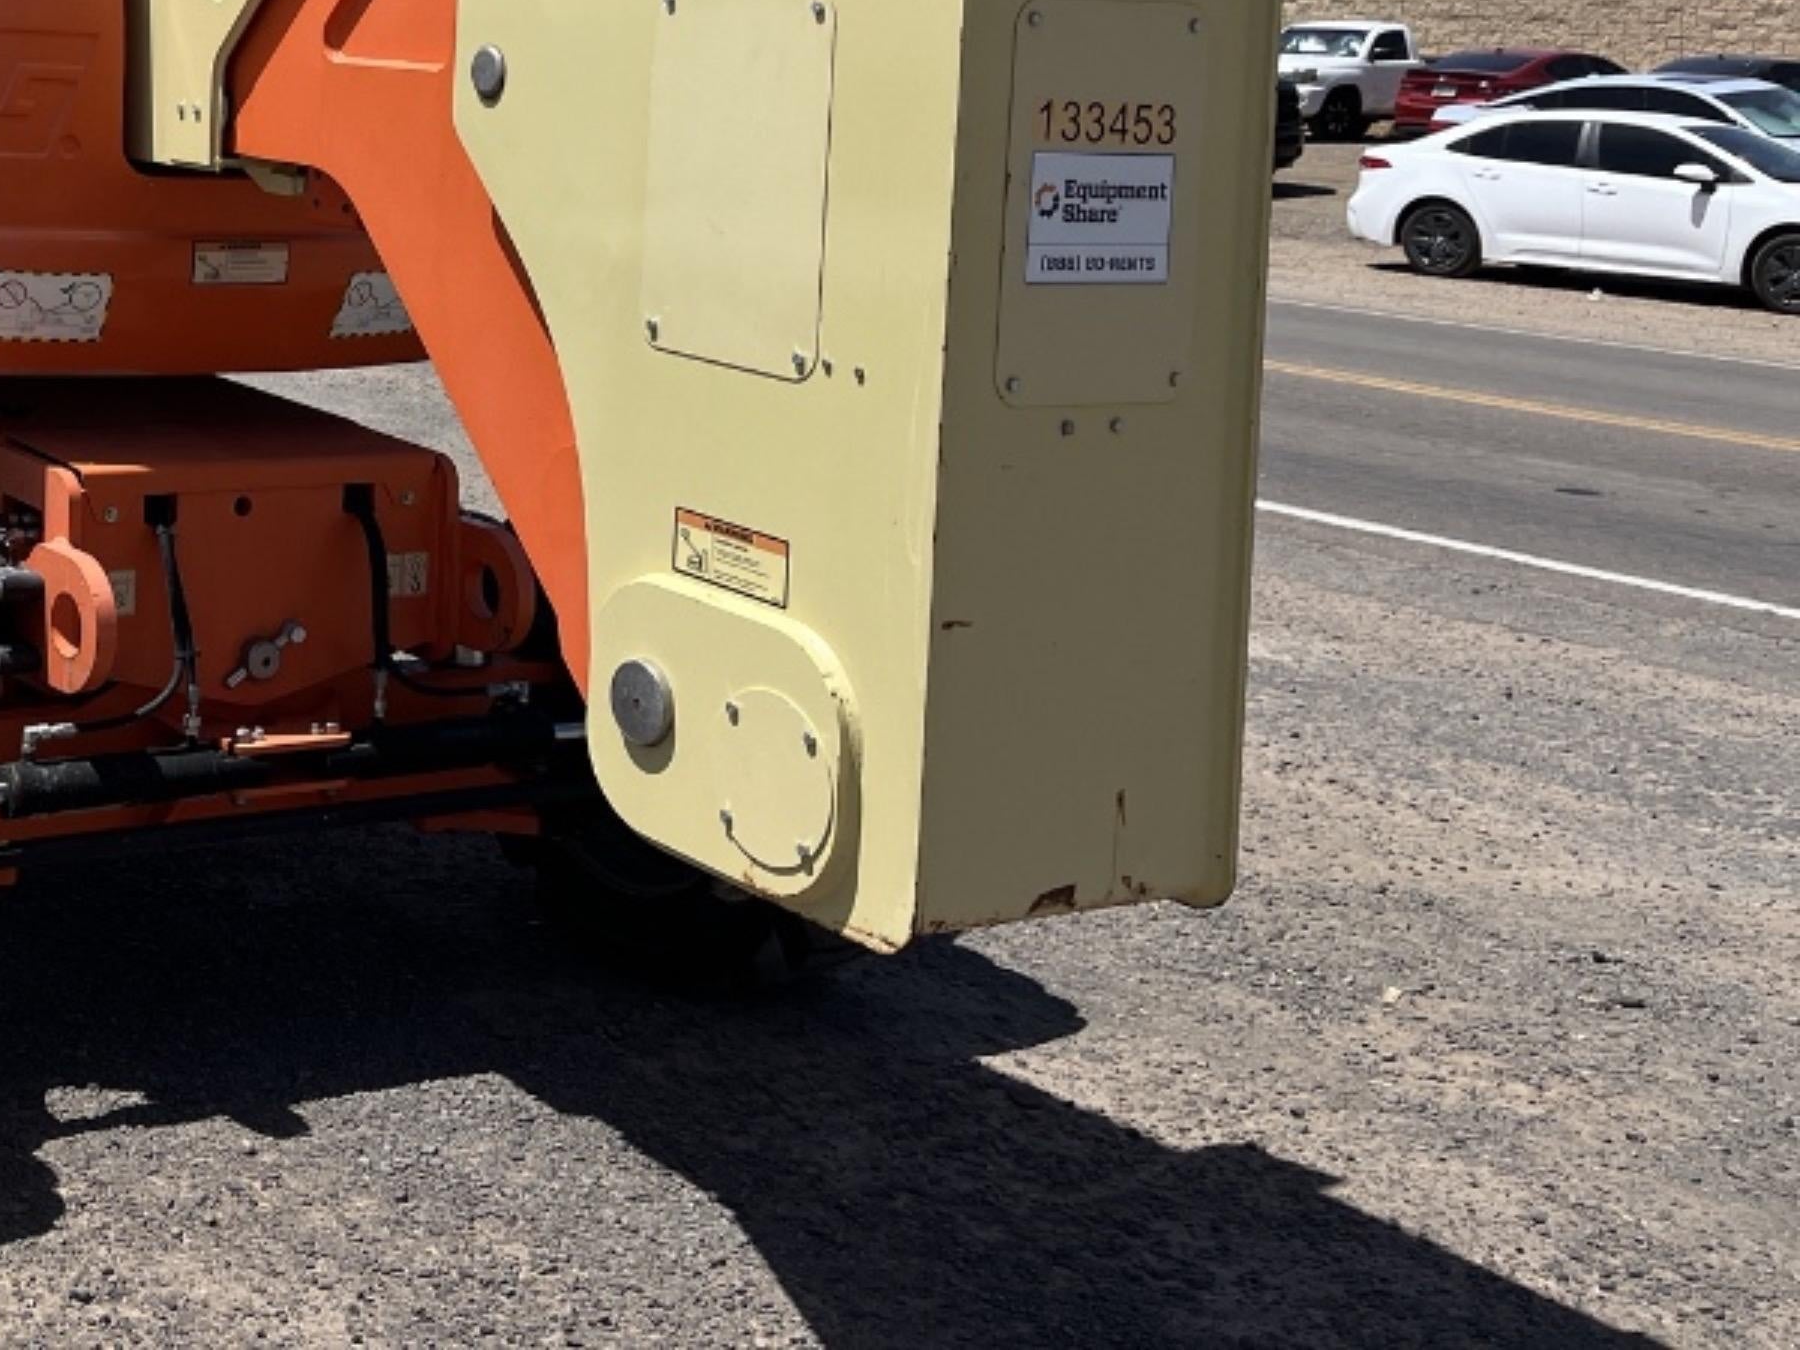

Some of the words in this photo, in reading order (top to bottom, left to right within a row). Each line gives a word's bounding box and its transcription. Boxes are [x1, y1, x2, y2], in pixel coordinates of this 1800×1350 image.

[1038, 99, 1178, 146] 133453
[1063, 178, 1169, 205] Equipment
[1061, 204, 1120, 224] Share
